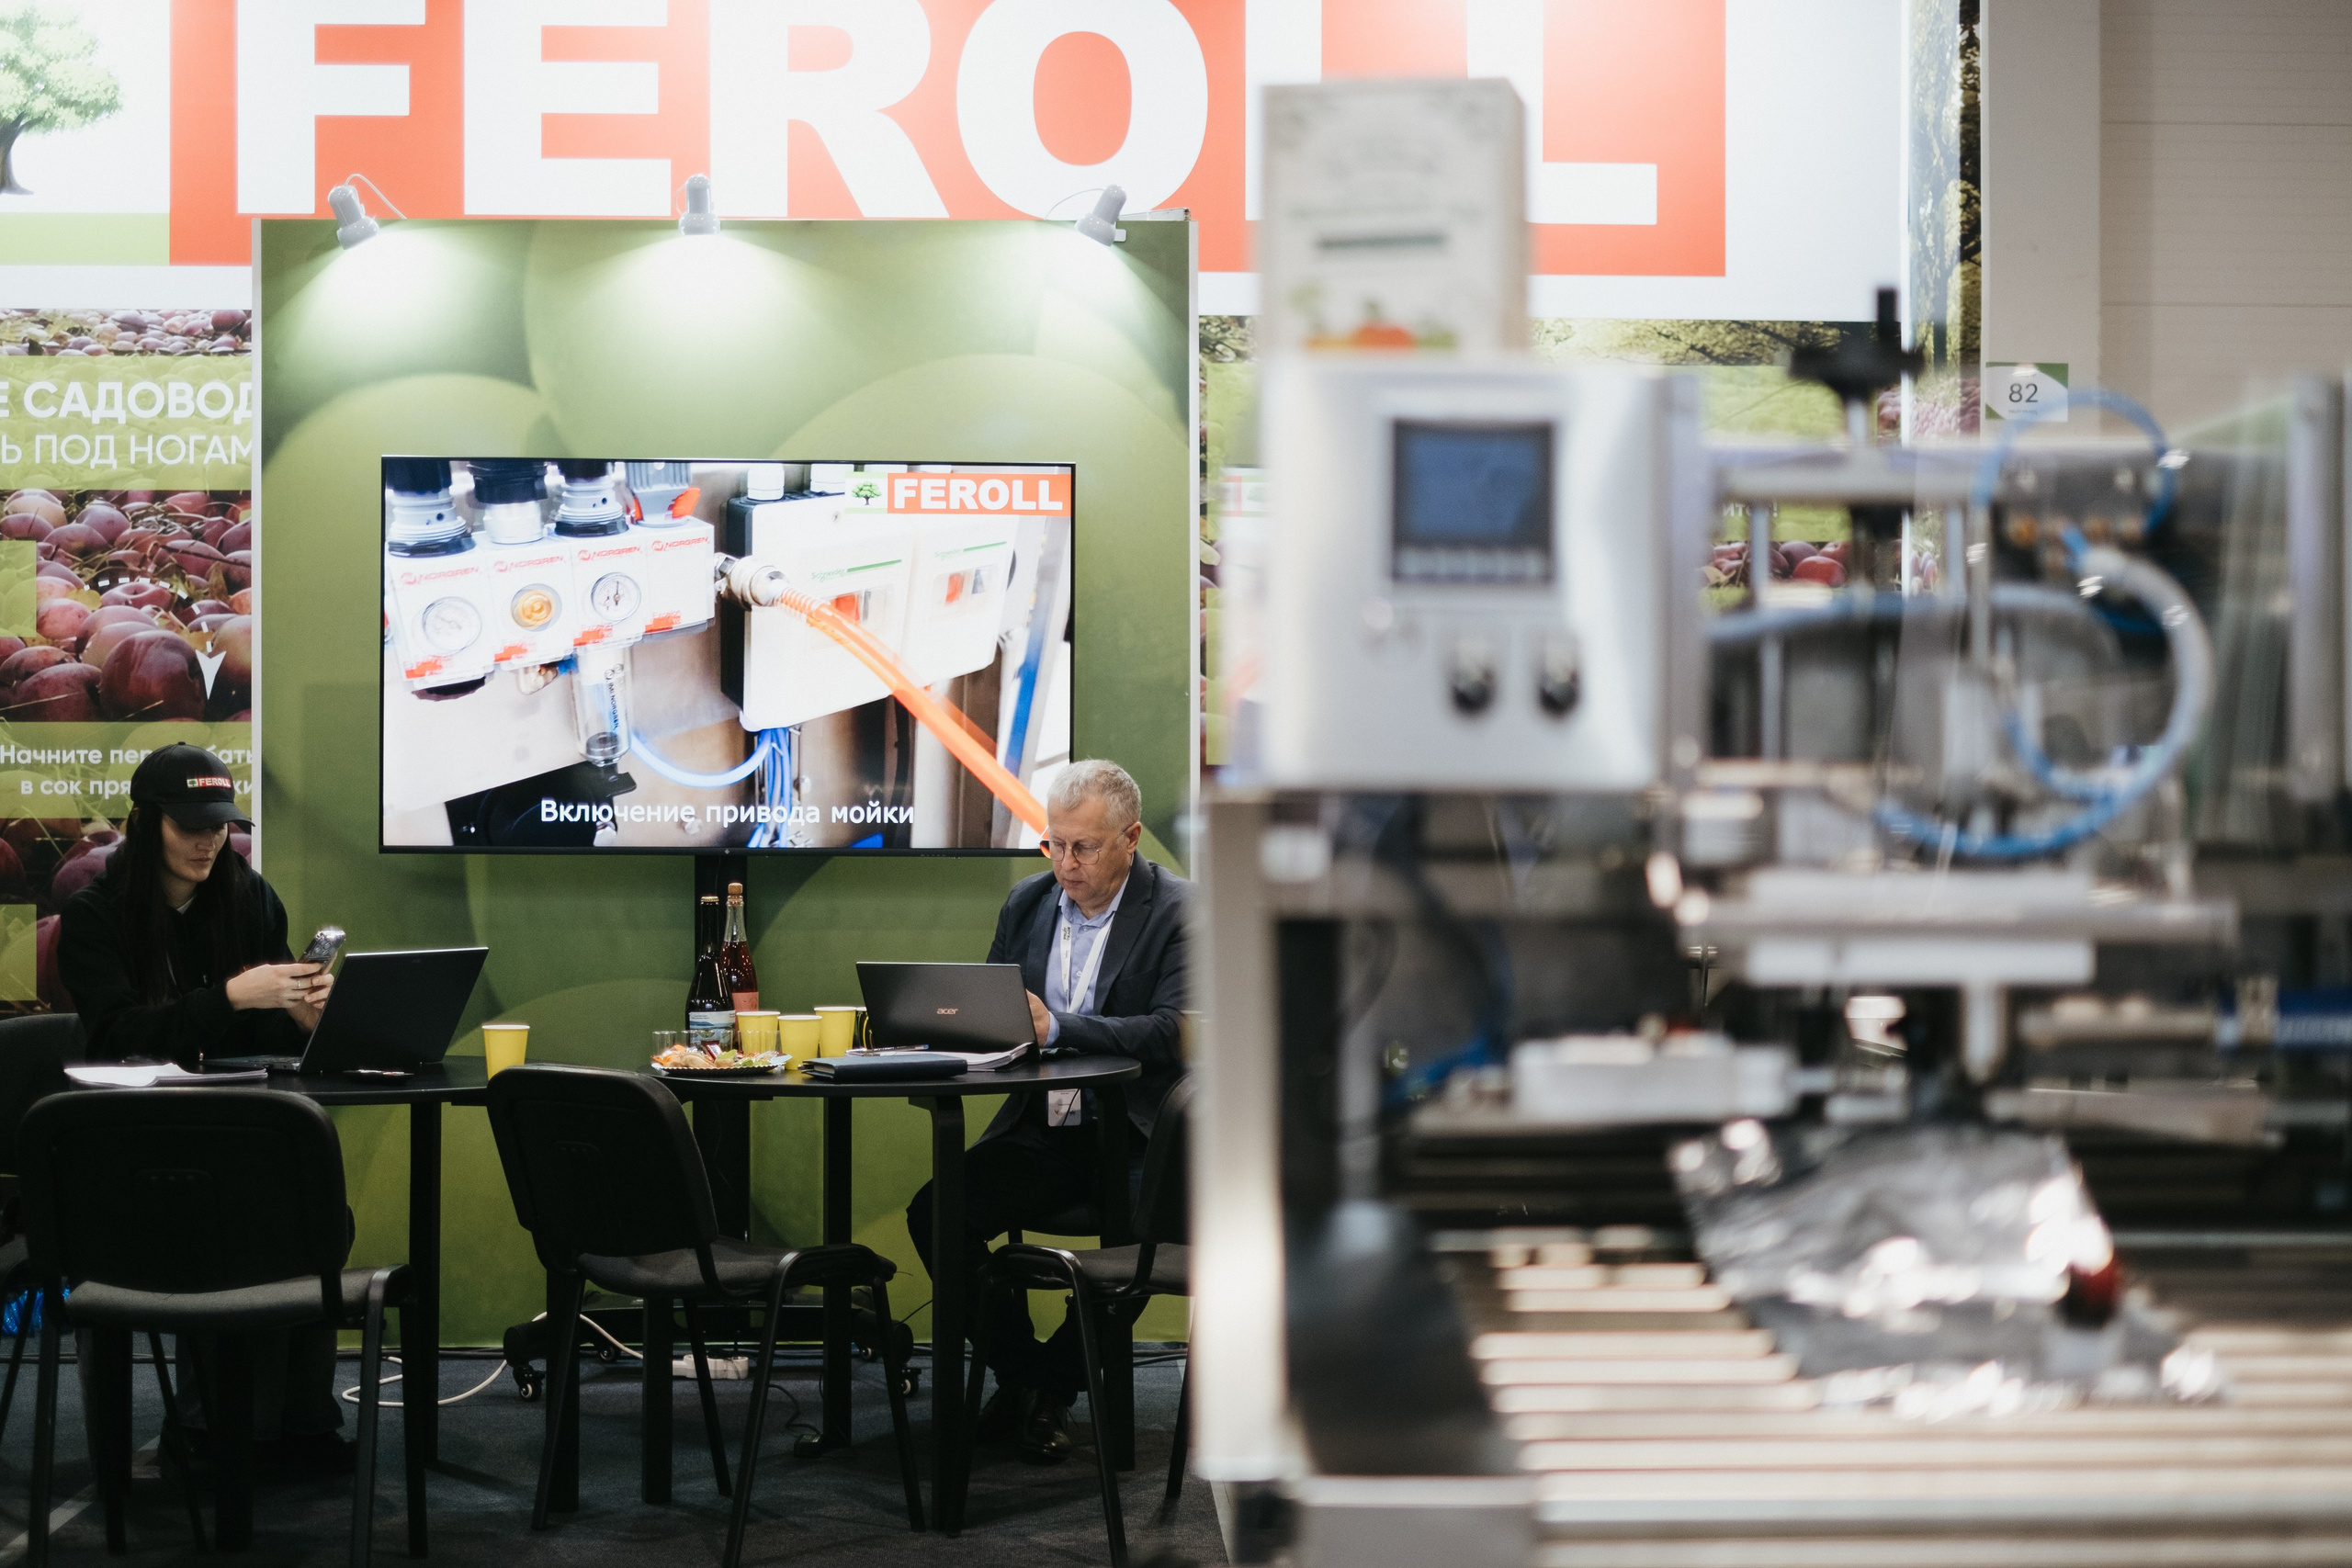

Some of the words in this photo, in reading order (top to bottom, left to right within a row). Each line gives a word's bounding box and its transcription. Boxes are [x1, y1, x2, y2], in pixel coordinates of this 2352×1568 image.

[2008, 383, 2039, 402] 82
[35, 434, 118, 469] ПОД
[894, 479, 1063, 510] FEROLL
[0, 745, 103, 764] Начните
[21, 780, 33, 795] в
[40, 780, 83, 795] сок
[198, 778, 232, 788] FEROLL
[540, 799, 695, 823] Включение
[706, 805, 820, 828] привода
[831, 801, 914, 824] мойки
